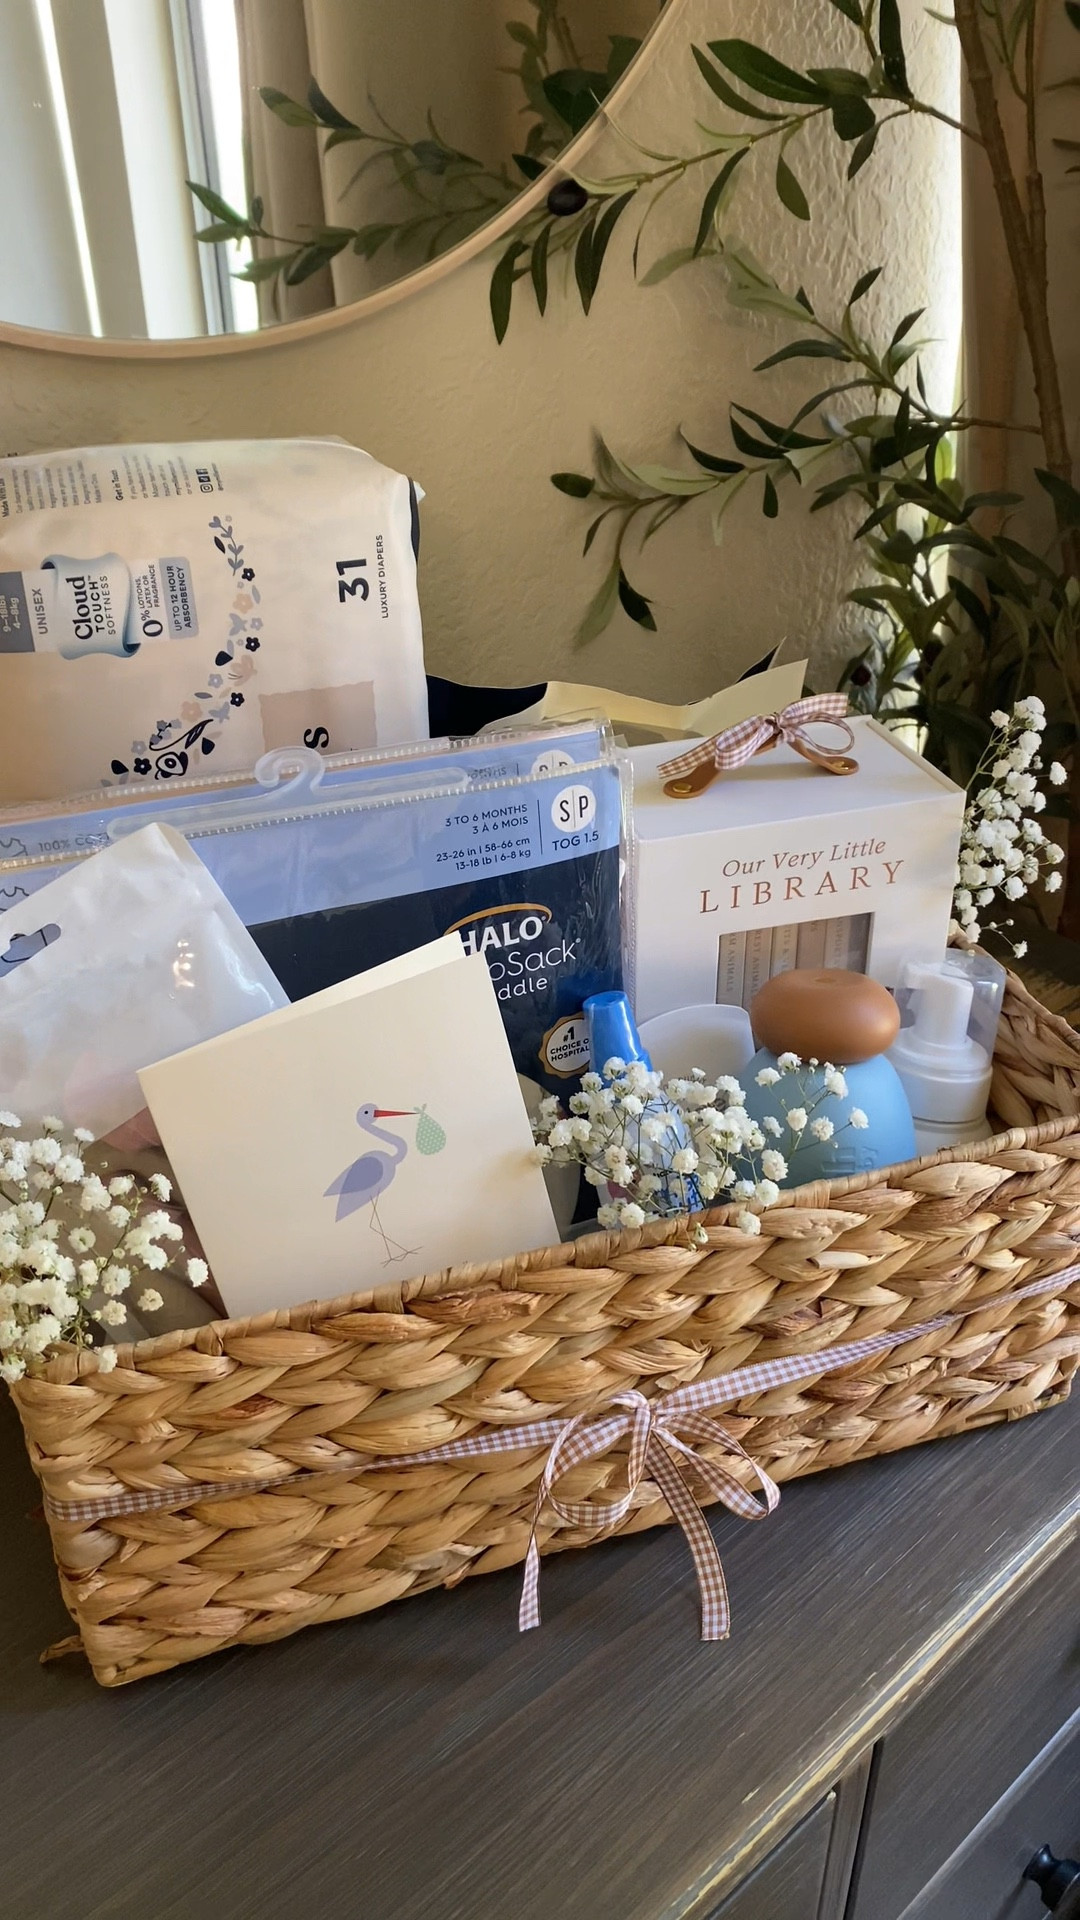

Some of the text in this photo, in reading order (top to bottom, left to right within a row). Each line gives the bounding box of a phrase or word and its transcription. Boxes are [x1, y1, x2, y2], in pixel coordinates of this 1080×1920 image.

[115, 489, 123, 501] Get
[142, 575, 153, 608] LATEX OR
[148, 564, 160, 608] FRAGRANCE
[336, 558, 370, 603] 31
[376, 534, 389, 619] LUXURY DIAPERS
[32, 588, 48, 635] UNISEX
[65, 576, 93, 640] Cloud
[100, 575, 116, 635] SOFTNESS
[166, 565, 182, 631] UP TO 12 HOUR
[176, 566, 192, 628] ABSORBENCY
[303, 726, 329, 749] S
[445, 804, 528, 828] 3 TO 6 MONTHS
[472, 826, 479, 835] 3
[492, 822, 499, 831] 6
[501, 816, 529, 828] MOIS
[38, 840, 70, 852] 100%
[436, 848, 465, 862] 23-26
[467, 847, 476, 856] in
[485, 840, 513, 852] 58-66
[515, 837, 531, 846] cm
[552, 830, 600, 851] TOG 1.5
[455, 858, 480, 871] 13-18
[482, 855, 492, 865] lb
[500, 851, 517, 861] 6-8
[519, 848, 531, 859] kg
[722, 838, 886, 877] Our Very Little
[700, 860, 904, 914] LIBRARY
[488, 937, 581, 981] oSack
[751, 956, 761, 993] ANIMAL
[498, 977, 548, 1000] ddle
[550, 1040, 581, 1055] CHOICE
[563, 1026, 575, 1042] #1
[551, 1045, 590, 1062] HOSPITAL
